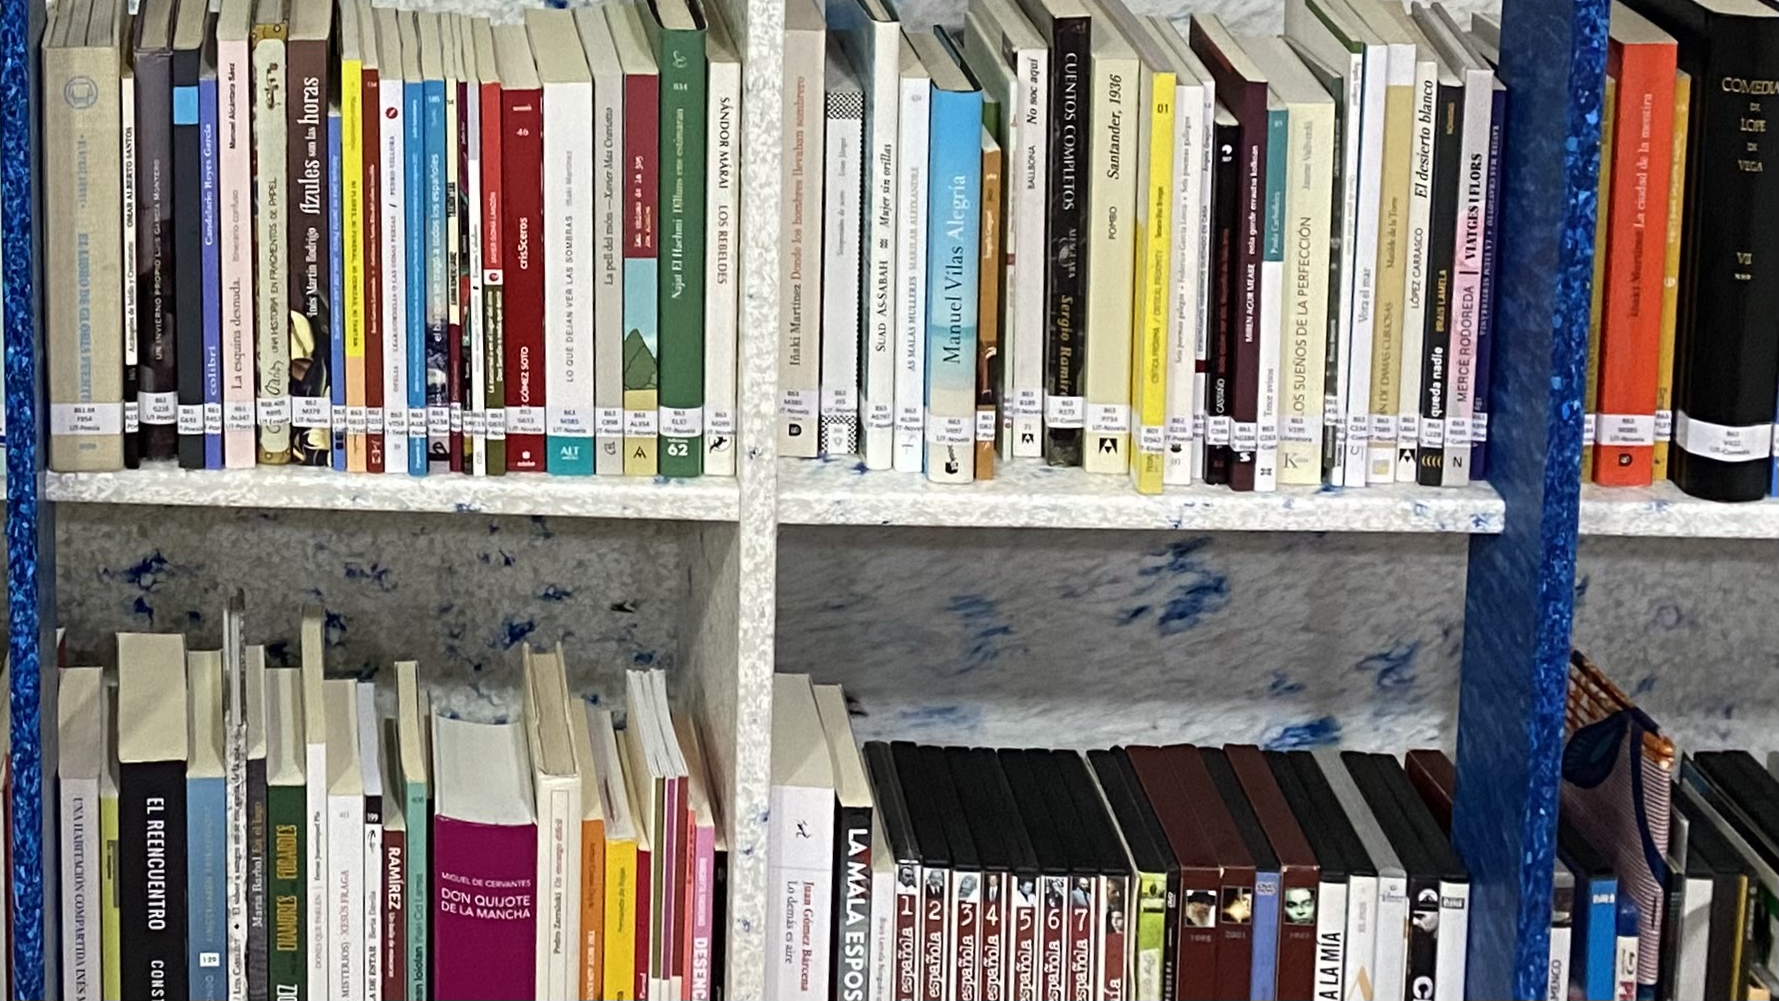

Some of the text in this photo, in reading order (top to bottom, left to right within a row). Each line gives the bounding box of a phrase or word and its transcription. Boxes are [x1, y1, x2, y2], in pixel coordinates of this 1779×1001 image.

[1026, 57, 1043, 125] No soc aquí
[1062, 53, 1079, 210] CUENTOS COMPLETOS
[1414, 80, 1435, 198] El desierto blanco
[1107, 75, 1124, 240] POMBO Santander, 1936
[943, 175, 969, 364] Manuel Vilas Alegría
[1430, 347, 1444, 417] queda nadie
[667, 443, 689, 459] 62
[147, 797, 166, 930] EL REENCUENTRO
[441, 887, 530, 906] DON QUIJOTE
[441, 902, 530, 918] DE LA MANCHA
[846, 829, 868, 925] LA MALA
[927, 900, 943, 997] española 2
[1315, 932, 1340, 1000] A LA MÍA
